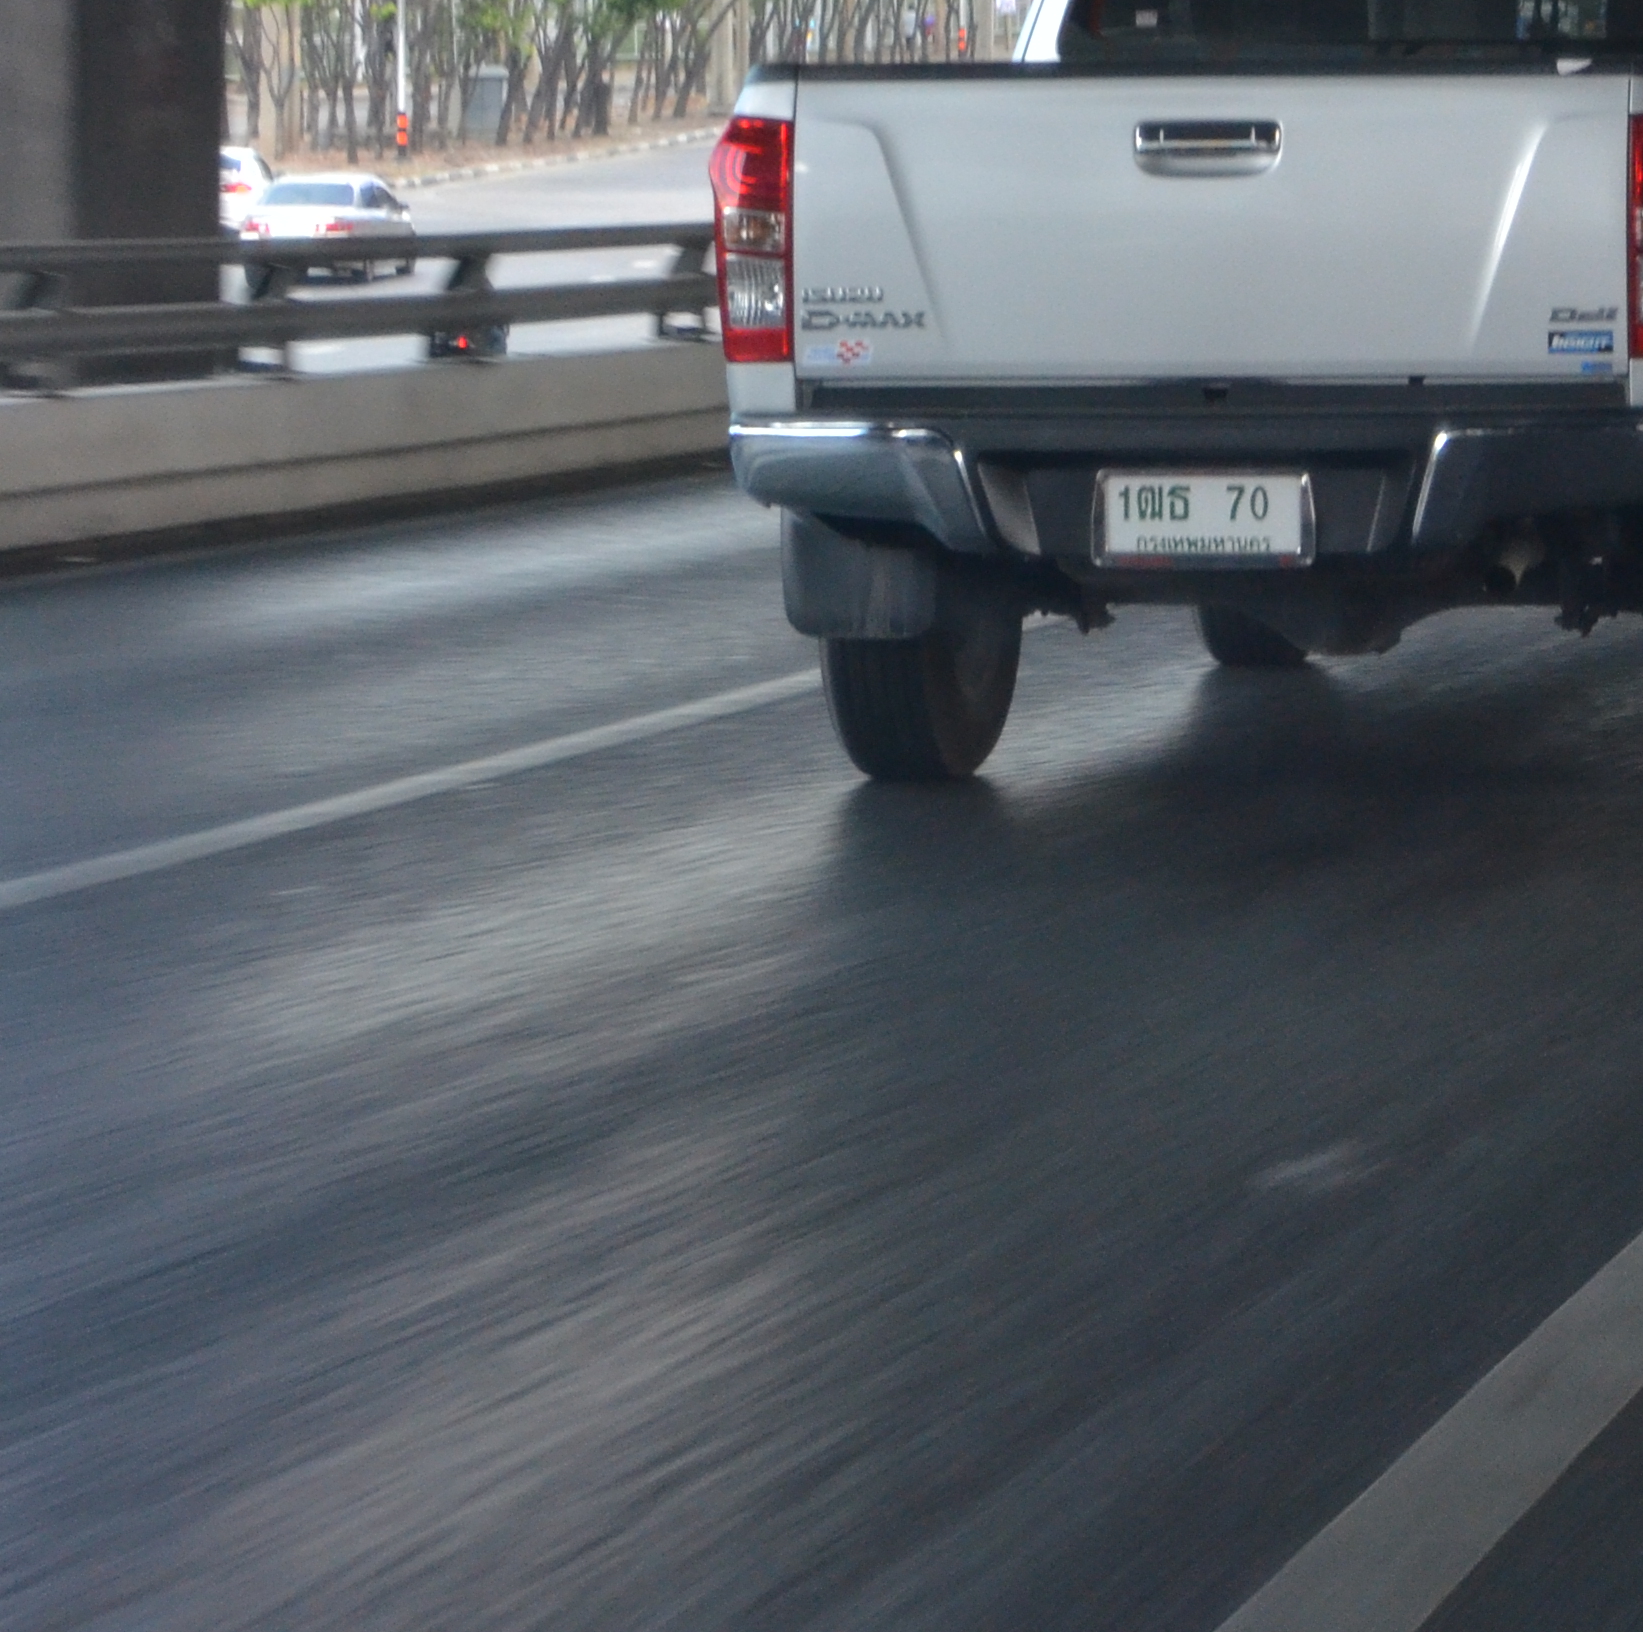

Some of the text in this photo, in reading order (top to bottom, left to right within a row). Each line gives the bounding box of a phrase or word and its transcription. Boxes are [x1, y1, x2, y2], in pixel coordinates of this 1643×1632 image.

[1226, 485, 1269, 521] 70
[1136, 535, 1271, 553] กรงเทพมหานคร
